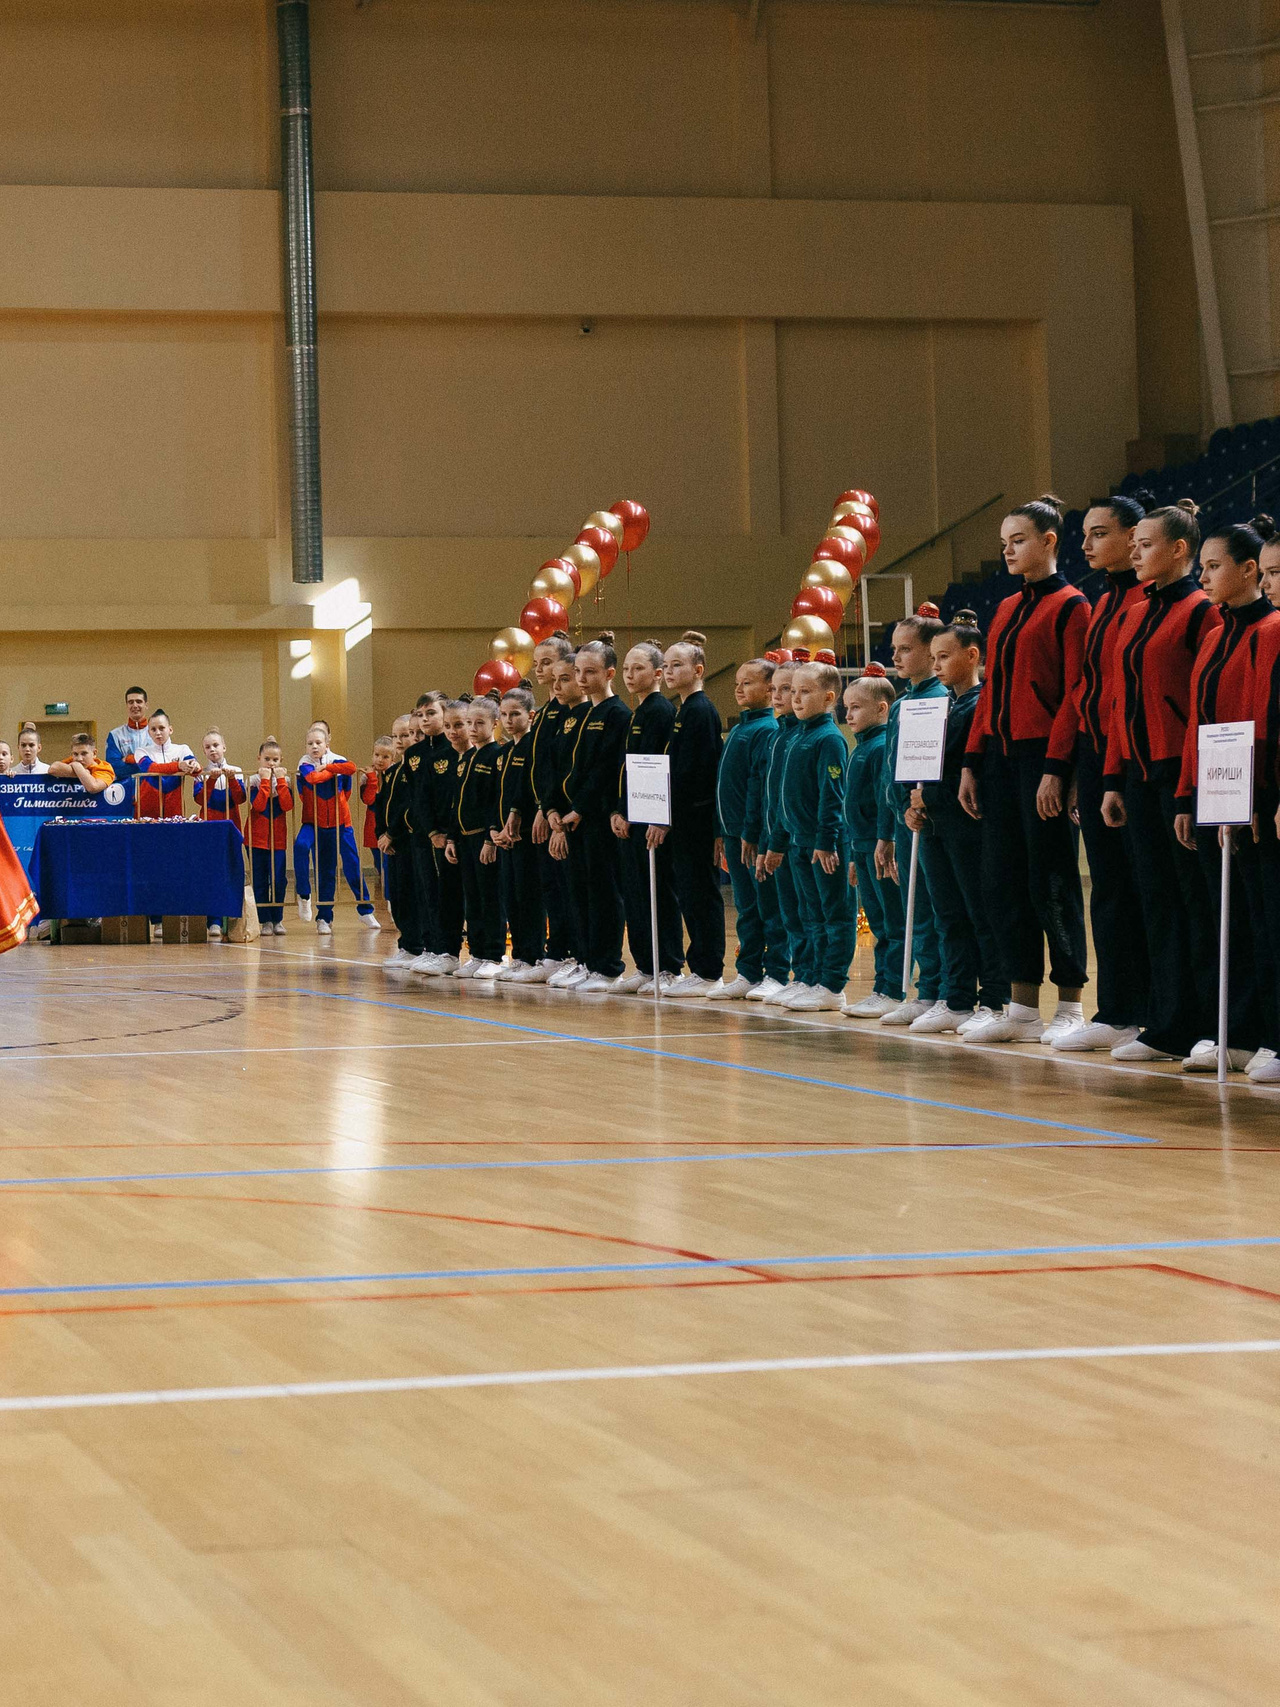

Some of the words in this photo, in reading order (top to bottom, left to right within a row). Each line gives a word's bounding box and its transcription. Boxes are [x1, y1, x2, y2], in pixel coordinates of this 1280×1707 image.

[1207, 767, 1242, 781] КИРИШИ
[632, 791, 666, 802] КАЛИНИНГРАД
[14, 797, 98, 809] Гимнастика
